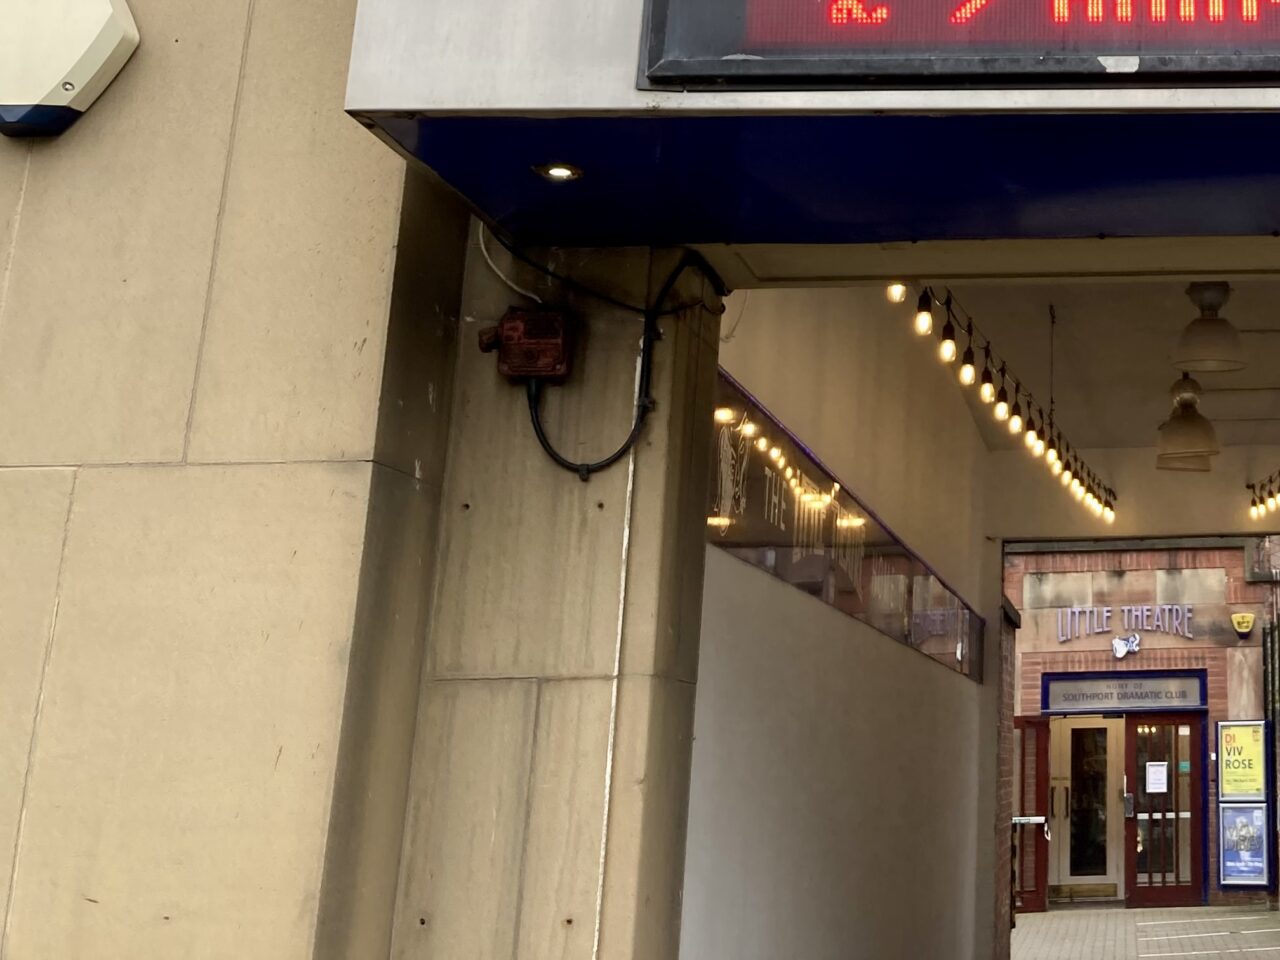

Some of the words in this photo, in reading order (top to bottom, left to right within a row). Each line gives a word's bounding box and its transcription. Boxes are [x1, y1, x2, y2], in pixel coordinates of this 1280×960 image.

[764, 465, 786, 532] THE
[1057, 606, 1112, 643] LITTLE
[1121, 604, 1194, 639] THEATRE
[1062, 691, 1114, 703] SOUTHPORT
[1117, 690, 1162, 701] DRAMATIC
[1164, 689, 1188, 700] CLUB
[1225, 745, 1243, 756] VIV
[1225, 759, 1253, 769] ROSE
